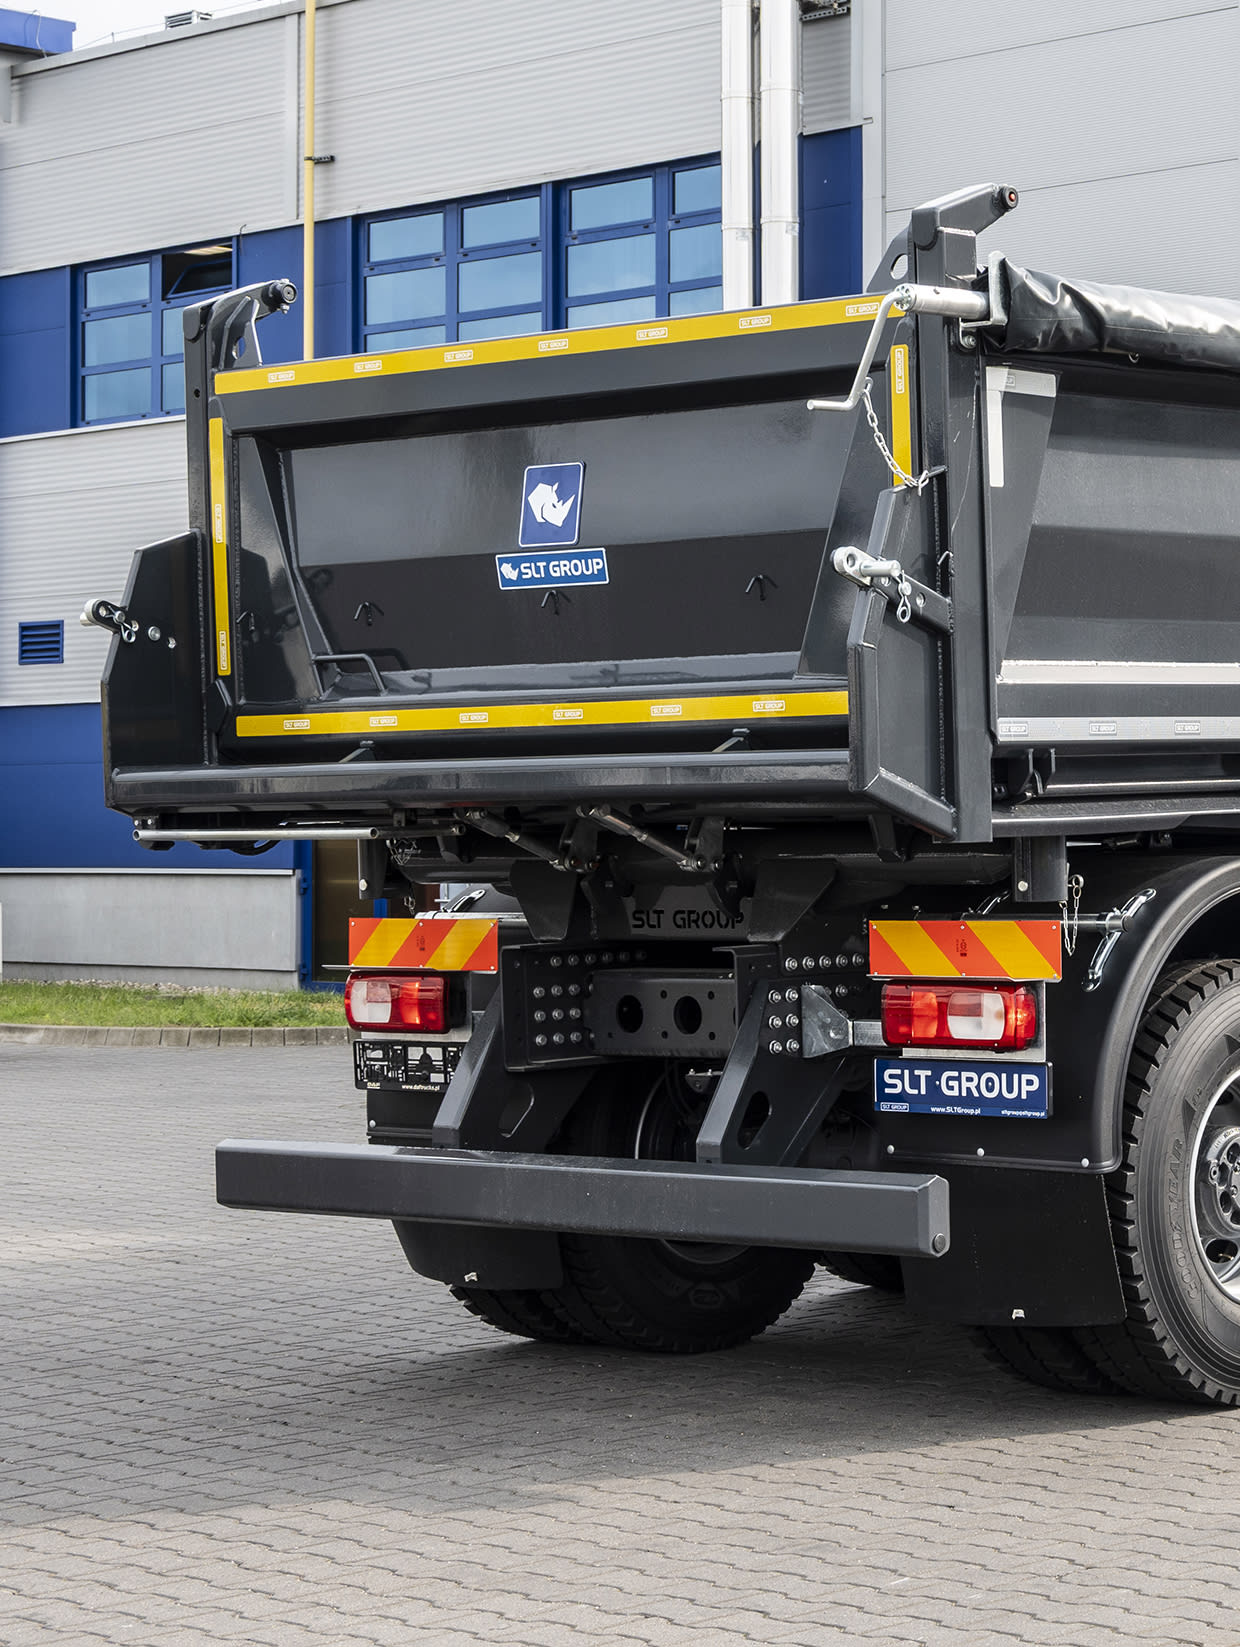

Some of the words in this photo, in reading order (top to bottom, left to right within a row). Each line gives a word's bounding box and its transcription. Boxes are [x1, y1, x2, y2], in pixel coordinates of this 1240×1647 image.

[860, 304, 878, 313] GROUP
[752, 316, 770, 325] GROUP
[520, 562, 546, 578] SLT
[549, 558, 603, 577] GROUP
[632, 910, 664, 928] SLT
[672, 910, 744, 929] GROUP
[884, 1068, 932, 1095] SLT
[940, 1071, 1040, 1100] GROUP
[930, 1106, 981, 1115] www.SLTGroup.pl
